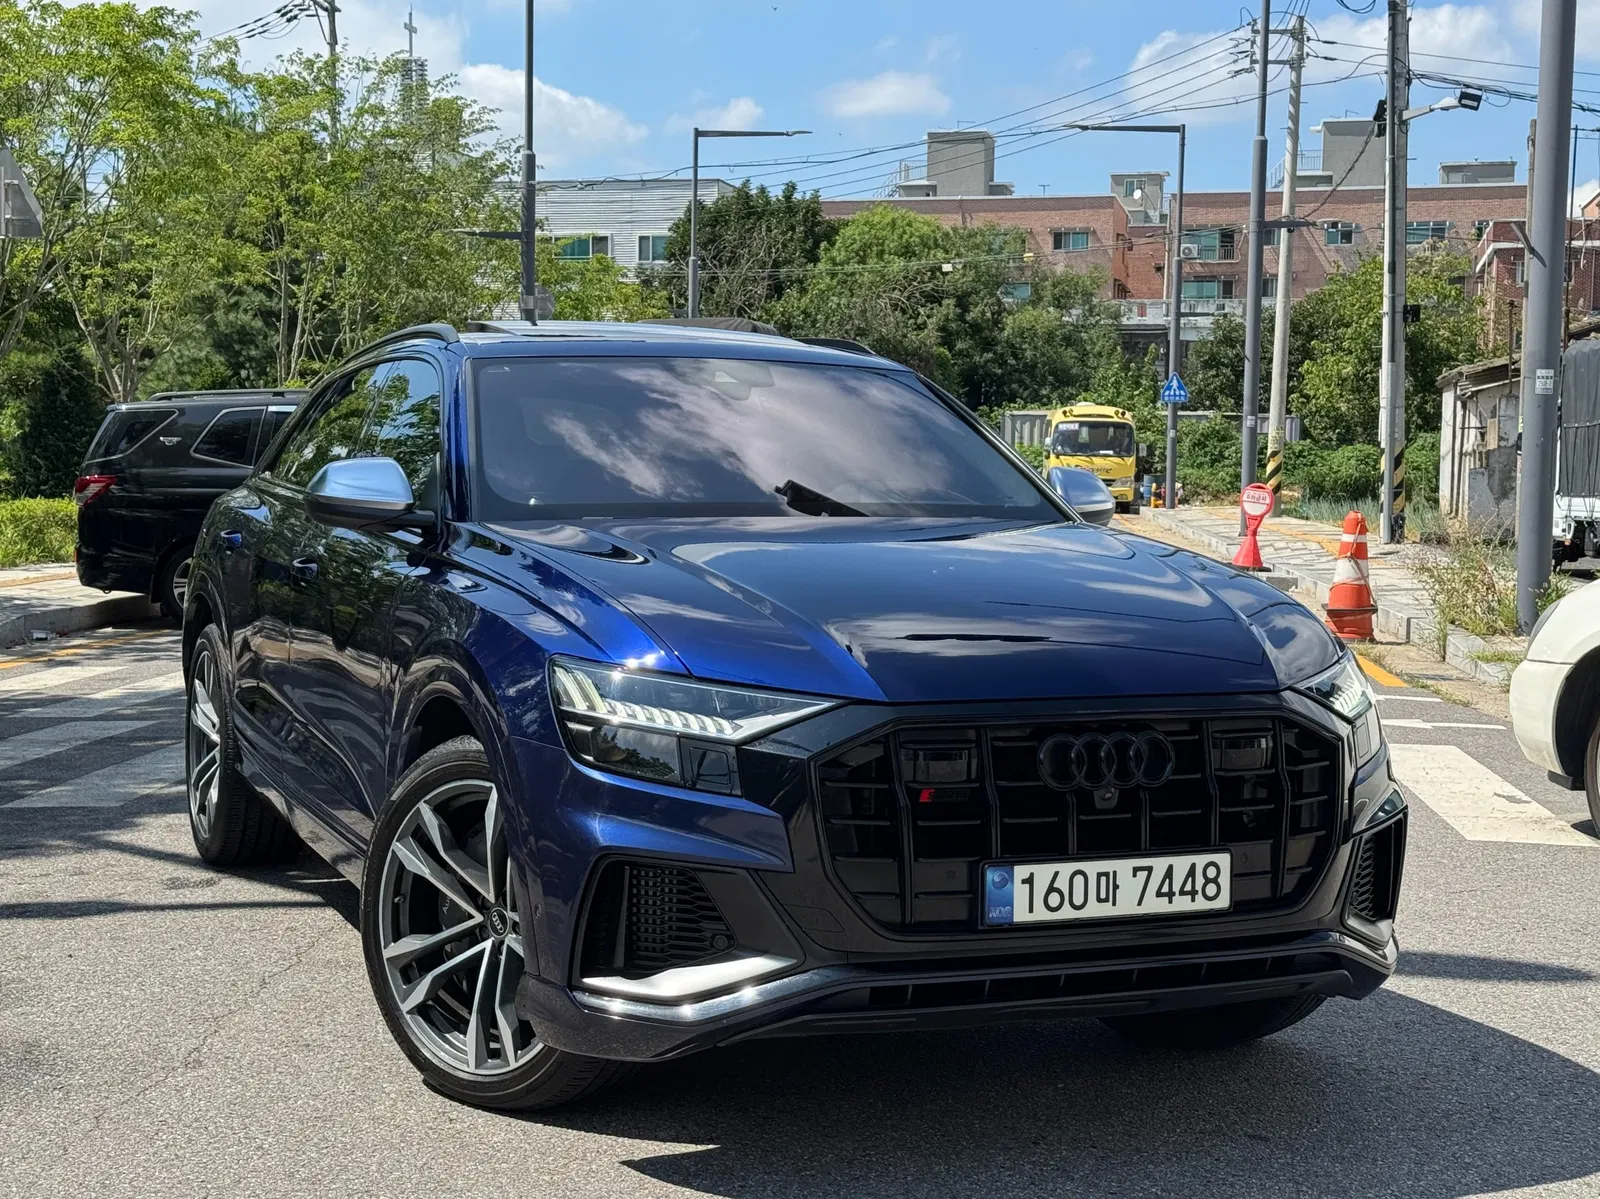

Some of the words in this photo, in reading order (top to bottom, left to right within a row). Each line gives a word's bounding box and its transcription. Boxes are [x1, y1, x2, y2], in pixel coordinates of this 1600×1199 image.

[1021, 869, 1120, 914] 160마
[1132, 860, 1222, 907] 7448
[989, 906, 1012, 918] KOR
